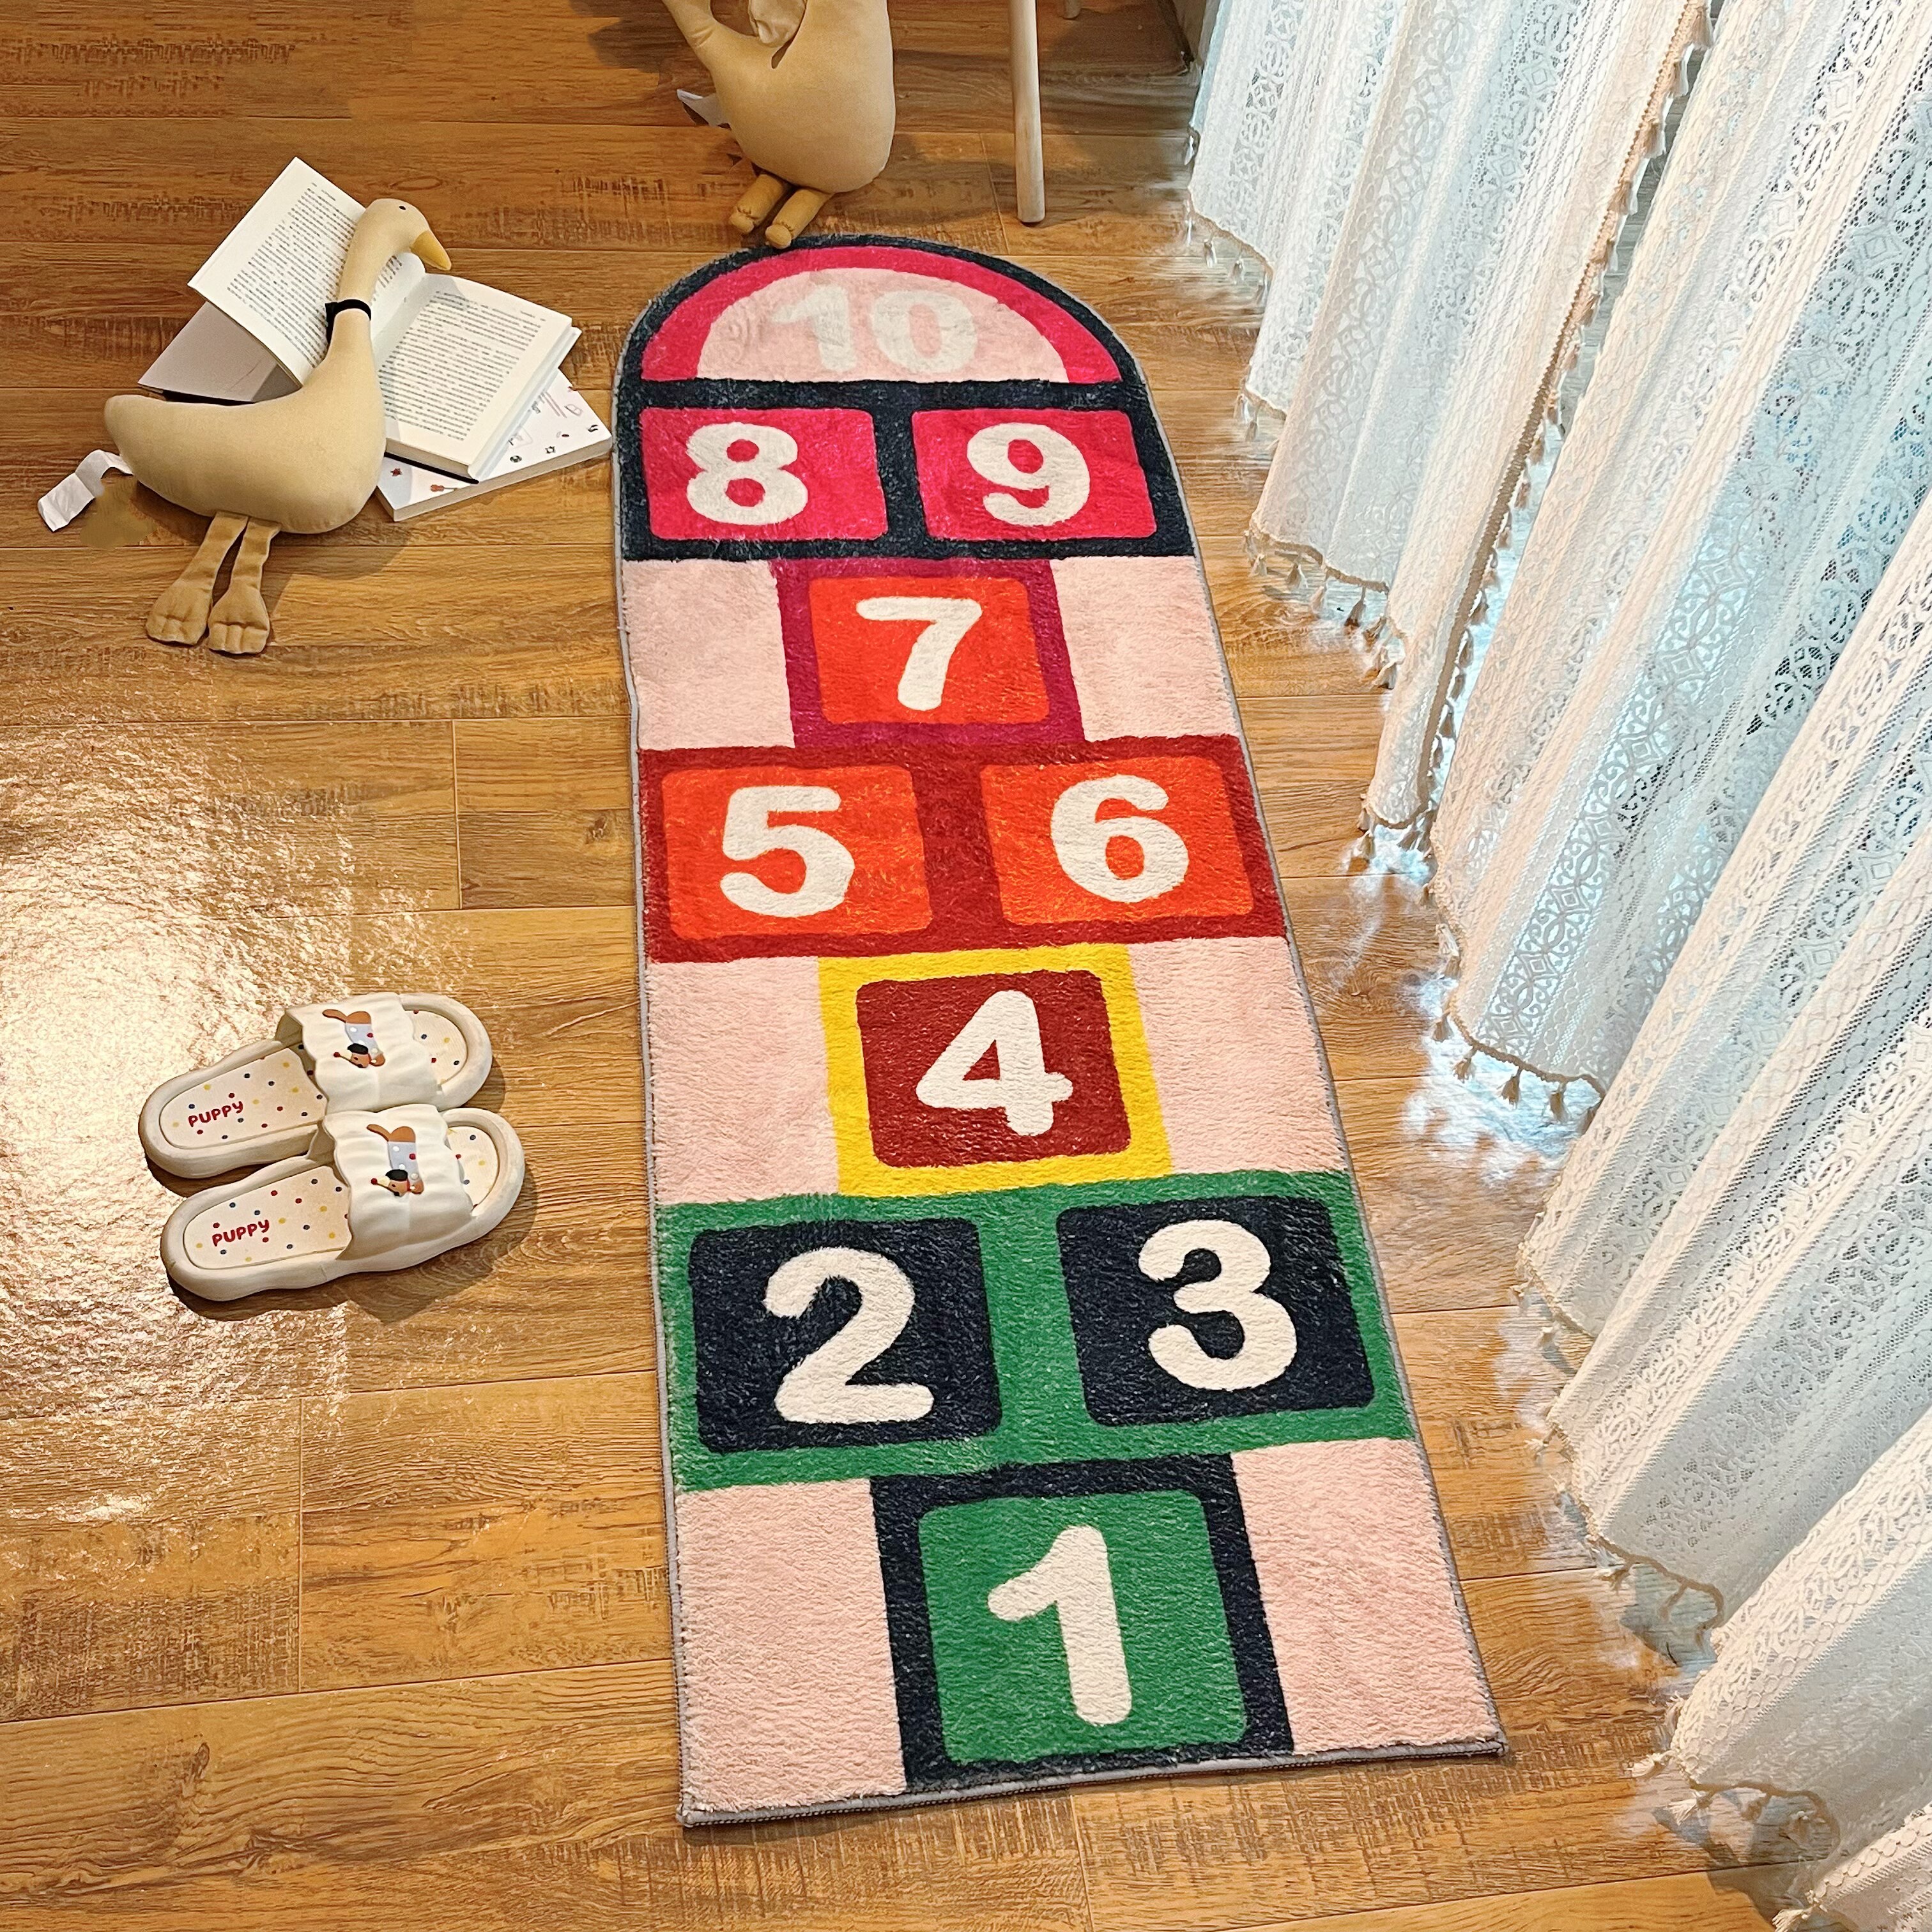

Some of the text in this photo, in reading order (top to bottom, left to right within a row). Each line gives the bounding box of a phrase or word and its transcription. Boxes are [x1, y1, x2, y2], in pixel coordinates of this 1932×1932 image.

[770, 284, 977, 373] 10
[687, 421, 808, 526] 8
[967, 422, 1091, 526] 9
[856, 597, 983, 711] 7
[720, 785, 854, 917] 5
[1051, 775, 1189, 903] 6
[188, 1101, 243, 1128] PUPPY
[916, 990, 1073, 1137] 4
[212, 1219, 270, 1247] PUPPY
[764, 1246, 934, 1425] 2
[1138, 1218, 1298, 1392] 3
[987, 1524, 1133, 1728] 1
